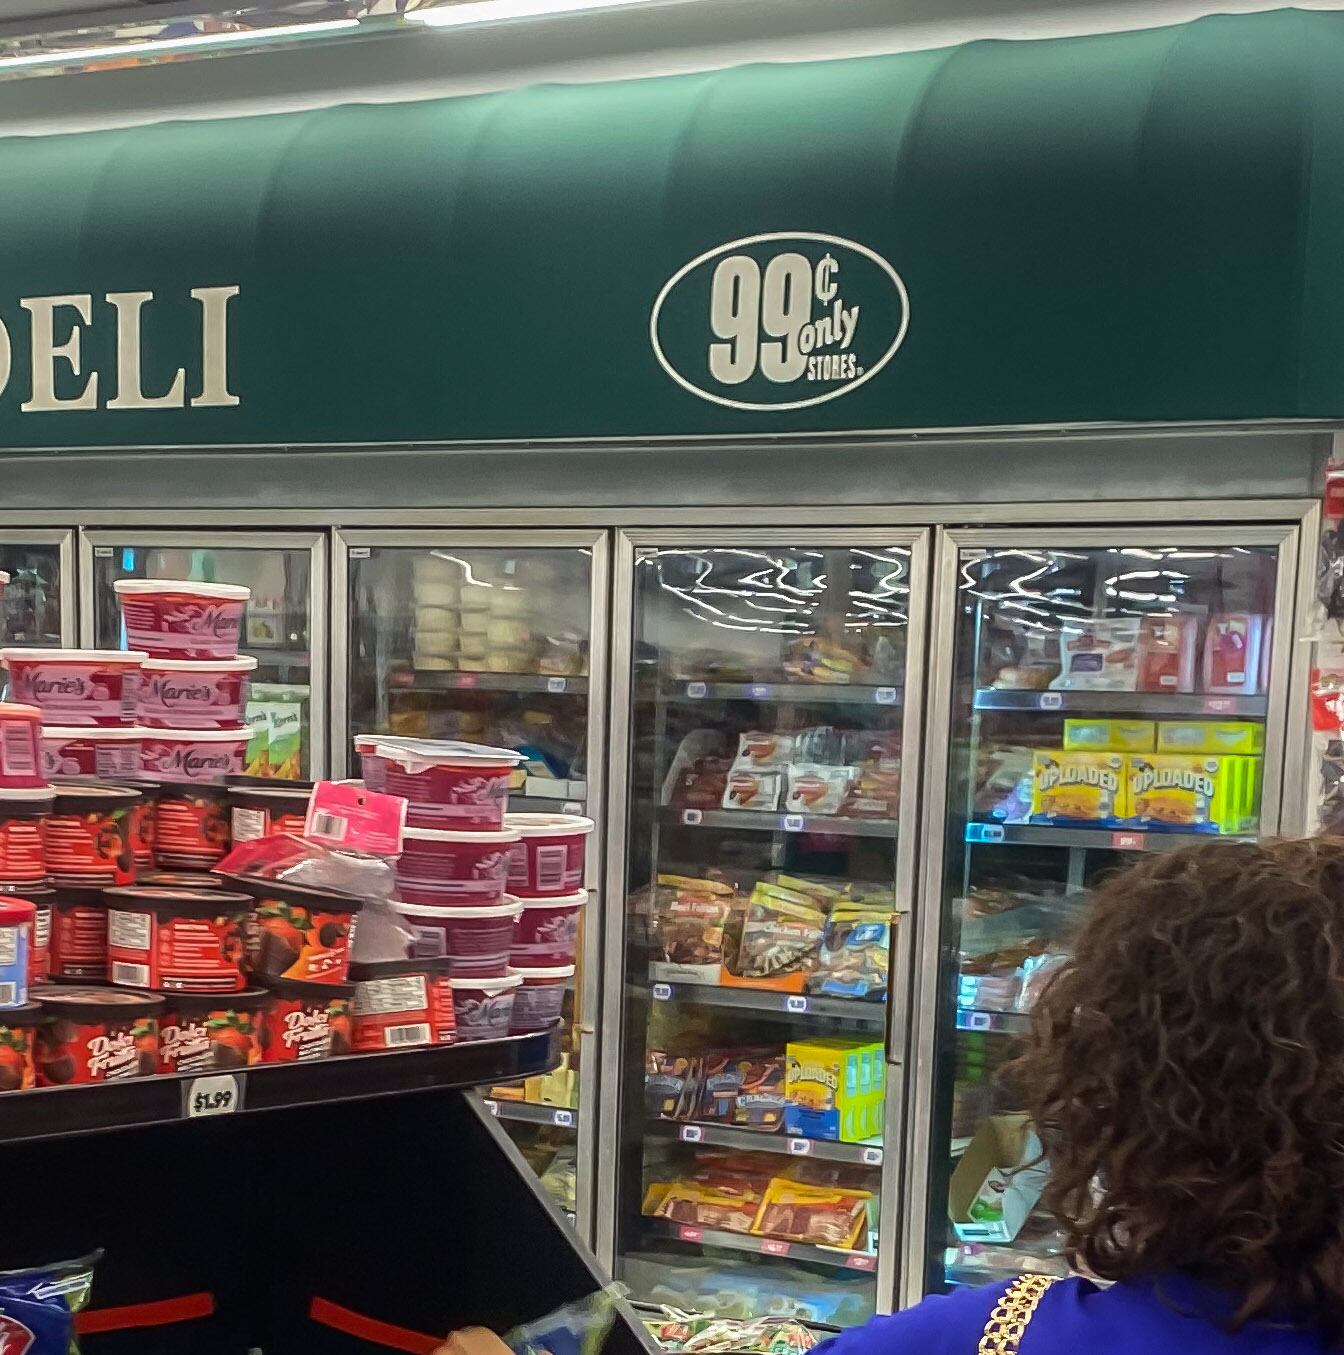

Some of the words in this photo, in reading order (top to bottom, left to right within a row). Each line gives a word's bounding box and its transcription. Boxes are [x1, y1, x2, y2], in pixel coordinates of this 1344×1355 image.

[798, 299, 860, 354] only
[807, 352, 857, 381] STORES
[193, 1090, 233, 1113] $1.99
